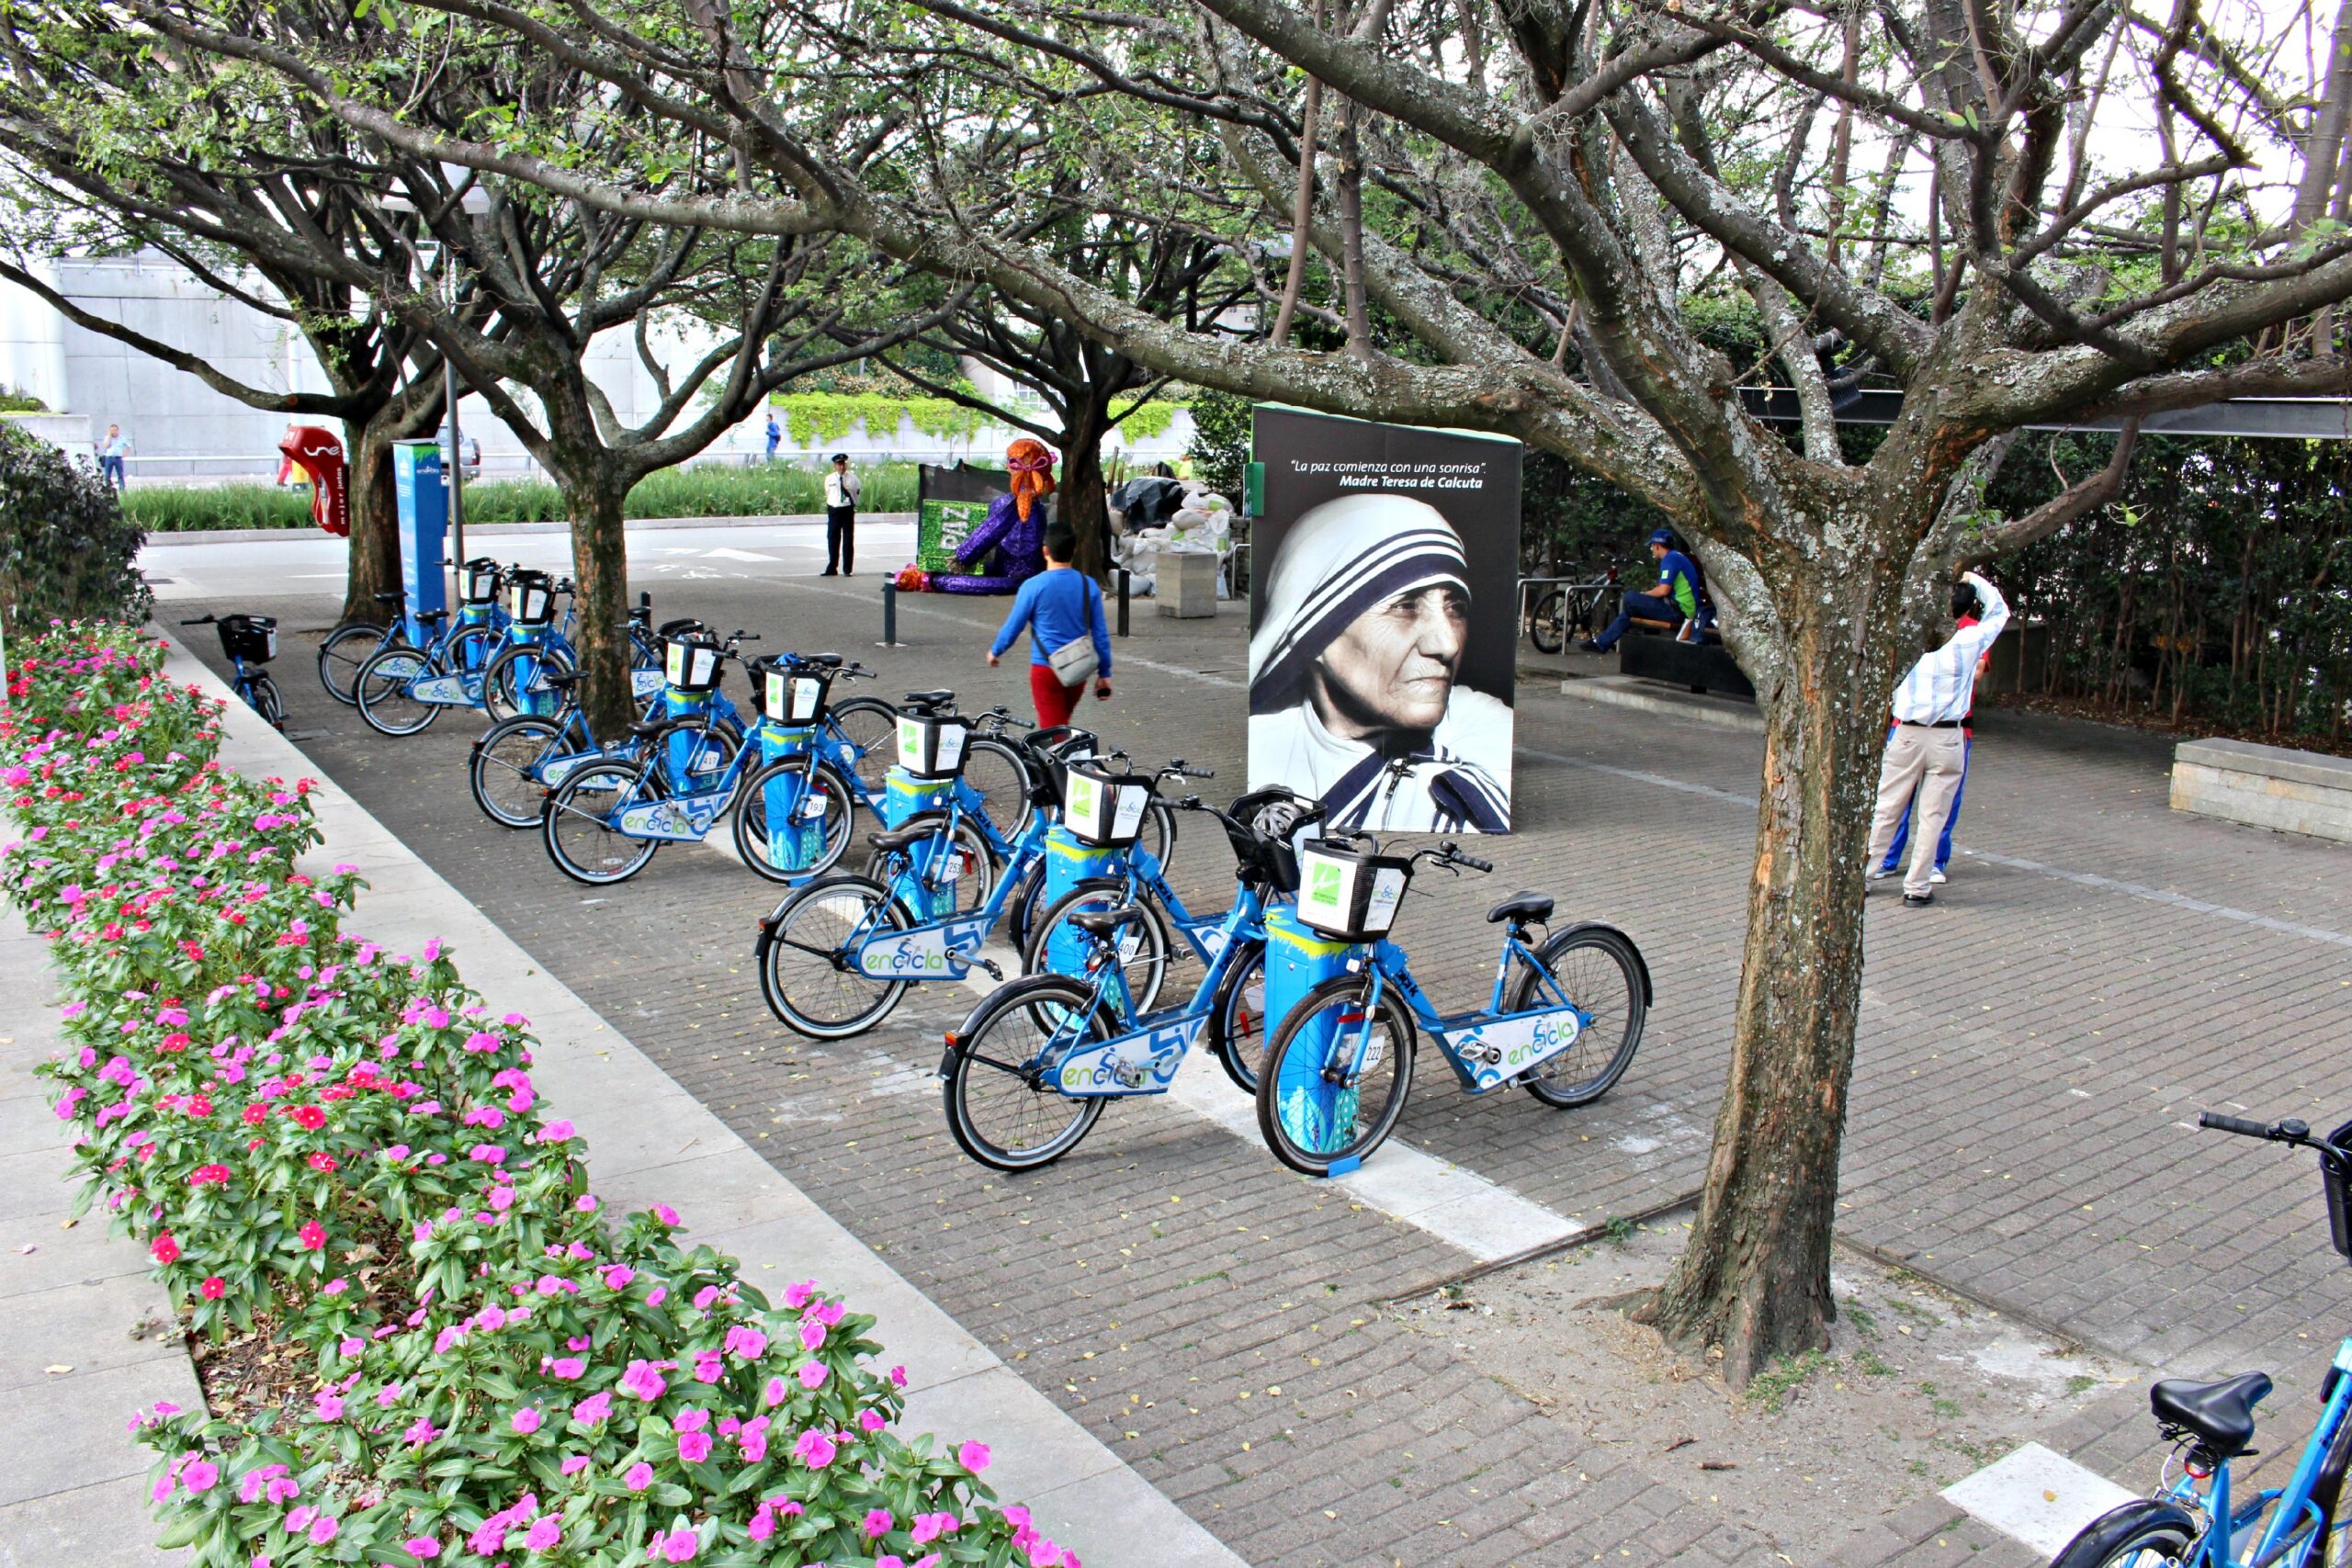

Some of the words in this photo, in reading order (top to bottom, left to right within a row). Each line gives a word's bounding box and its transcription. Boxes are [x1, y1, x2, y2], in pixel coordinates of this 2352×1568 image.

[304, 446, 340, 457] une
[1291, 459, 1308, 471] “La
[1310, 462, 1330, 474] paz
[1333, 461, 1388, 472] comienza
[1390, 463, 1411, 473] con
[1413, 464, 1436, 473] una
[1339, 475, 1378, 487] Madre
[1381, 475, 1418, 487] Teresa
[1419, 476, 1435, 488] de
[1437, 476, 1483, 489] Calcuta
[941, 506, 970, 549] PAZ
[808, 801, 824, 813] 193
[624, 814, 687, 835] encicla
[948, 862, 962, 874] 253
[865, 946, 943, 970] encicla
[1508, 1020, 1575, 1066] encicla
[1366, 1045, 1381, 1061] 222
